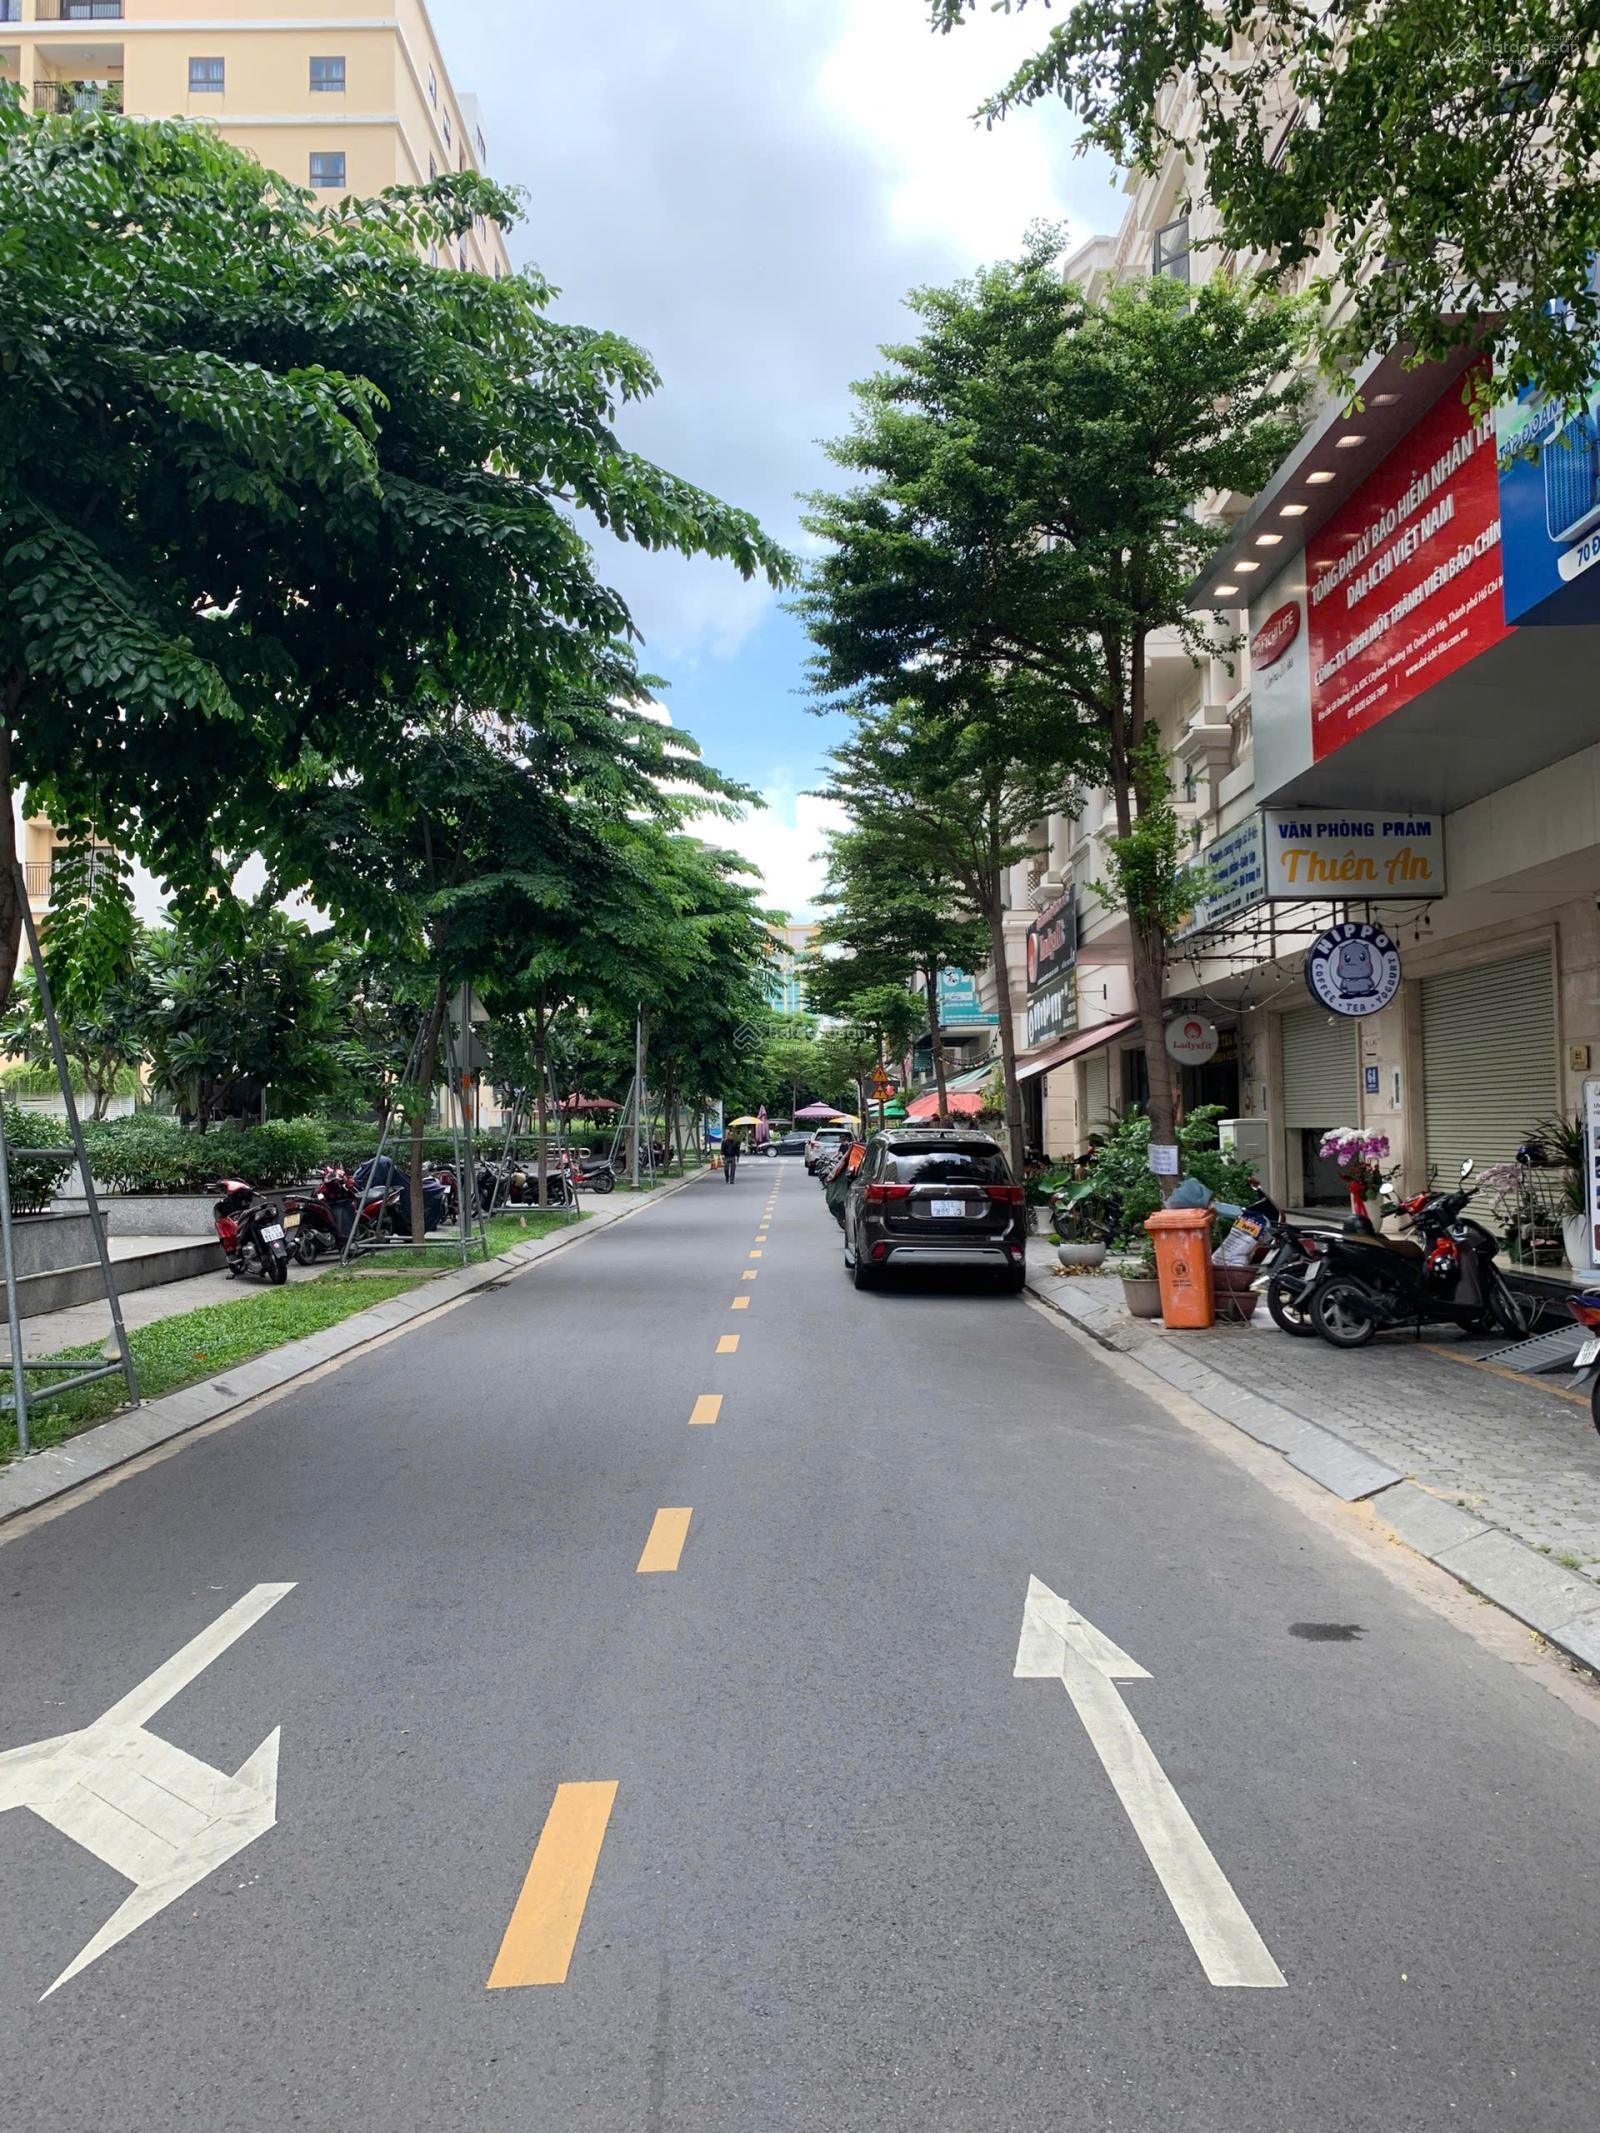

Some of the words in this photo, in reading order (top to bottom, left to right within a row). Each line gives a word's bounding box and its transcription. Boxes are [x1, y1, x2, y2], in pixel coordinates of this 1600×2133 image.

[1339, 545, 1357, 582] ĐẠI
[1357, 527, 1370, 562] LÝ
[1371, 507, 1396, 550] BẢO
[1397, 470, 1431, 525] HIỂM
[1431, 429, 1475, 491] NHÂN
[1392, 524, 1421, 567] VIỆT
[1420, 493, 1455, 542] NAM
[1577, 543, 1590, 567] 70
[1279, 821, 1312, 839] VĂN
[1317, 819, 1375, 838] PHÒNG
[1280, 848, 1380, 883] Thiên
[1384, 847, 1433, 885] An
[1317, 923, 1390, 955] HIPPO
[1315, 963, 1337, 1004] COFFEE
[1346, 1003, 1366, 1013] TEA
[1375, 957, 1398, 1005] YOGOURT
[1367, 1068, 1377, 1084] 64
